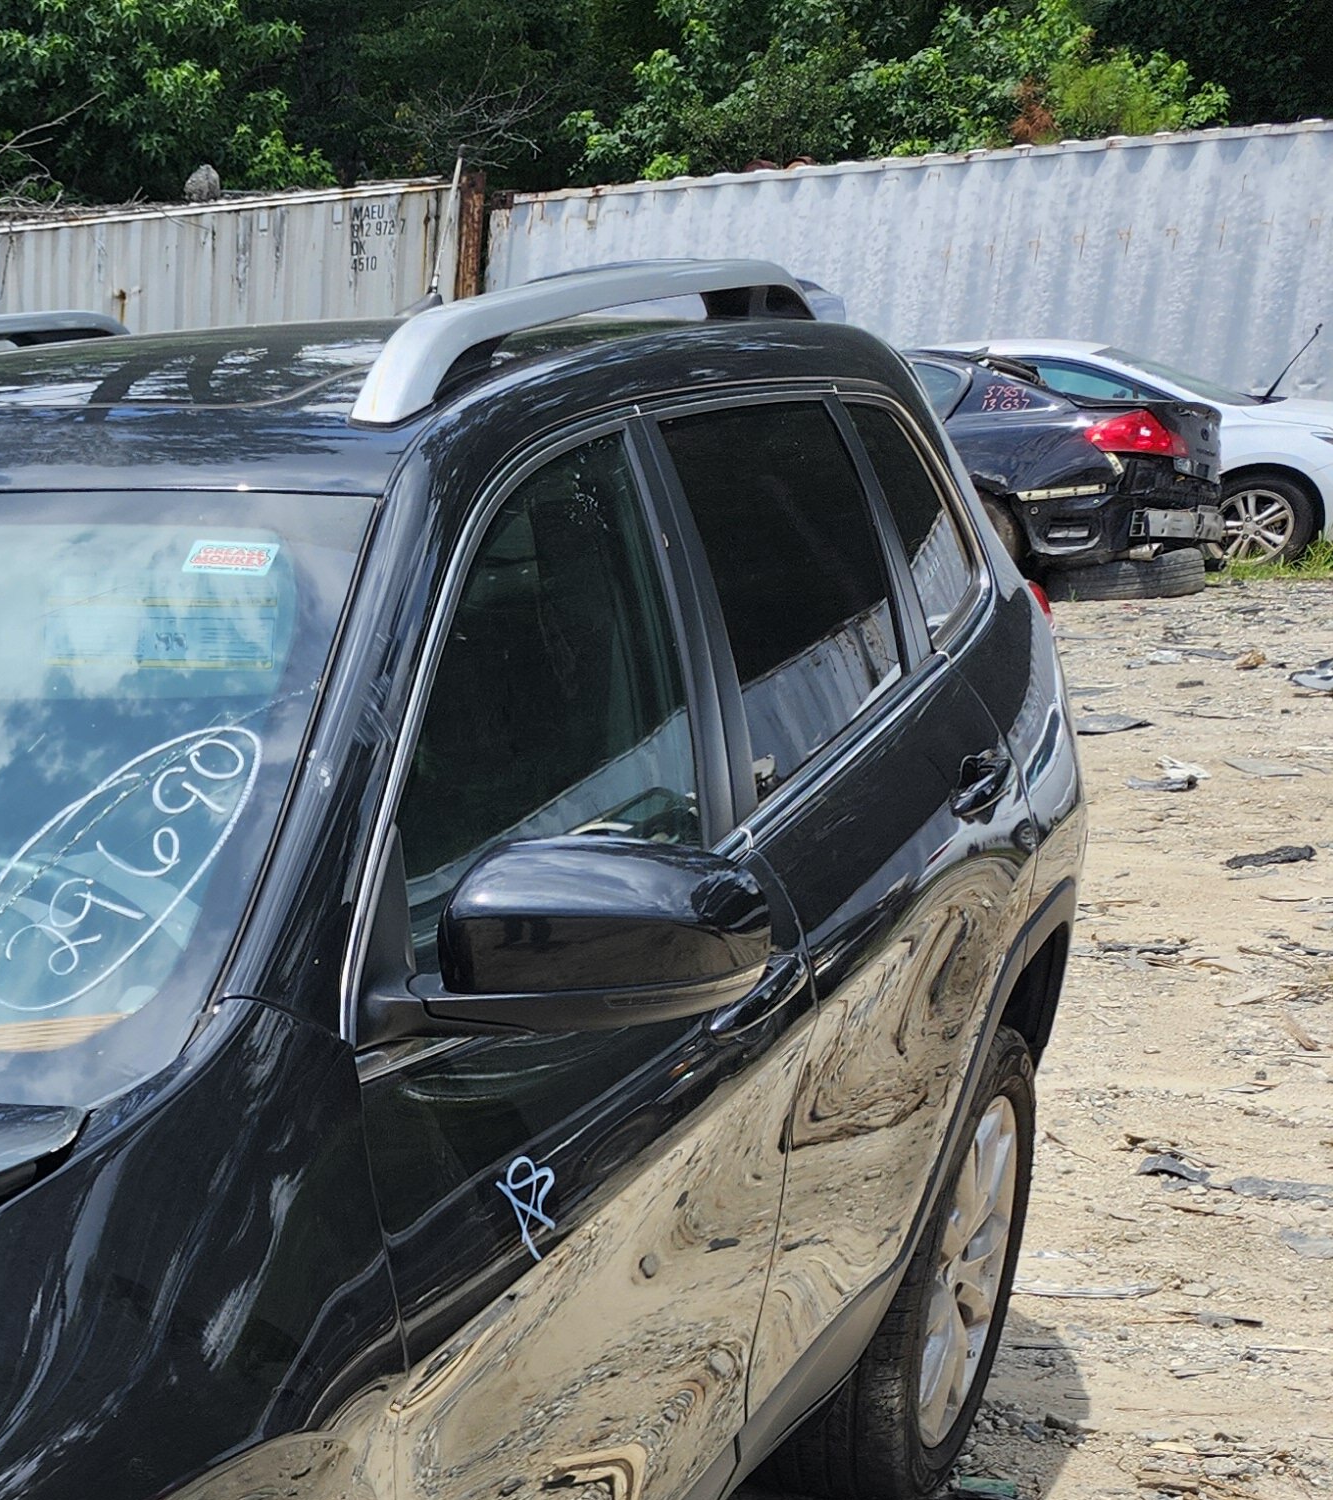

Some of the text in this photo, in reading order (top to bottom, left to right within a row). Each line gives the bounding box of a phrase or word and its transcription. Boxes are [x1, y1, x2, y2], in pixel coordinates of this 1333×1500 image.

[352, 204, 385, 221] MAEU
[375, 220, 395, 236] 972
[351, 240, 366, 256] DK
[351, 256, 377, 272] 4510
[981, 398, 1030, 411] 13 G37
[202, 547, 267, 557] GREASE
[193, 555, 268, 567] MONKEY
[6, 738, 244, 975] 29690
